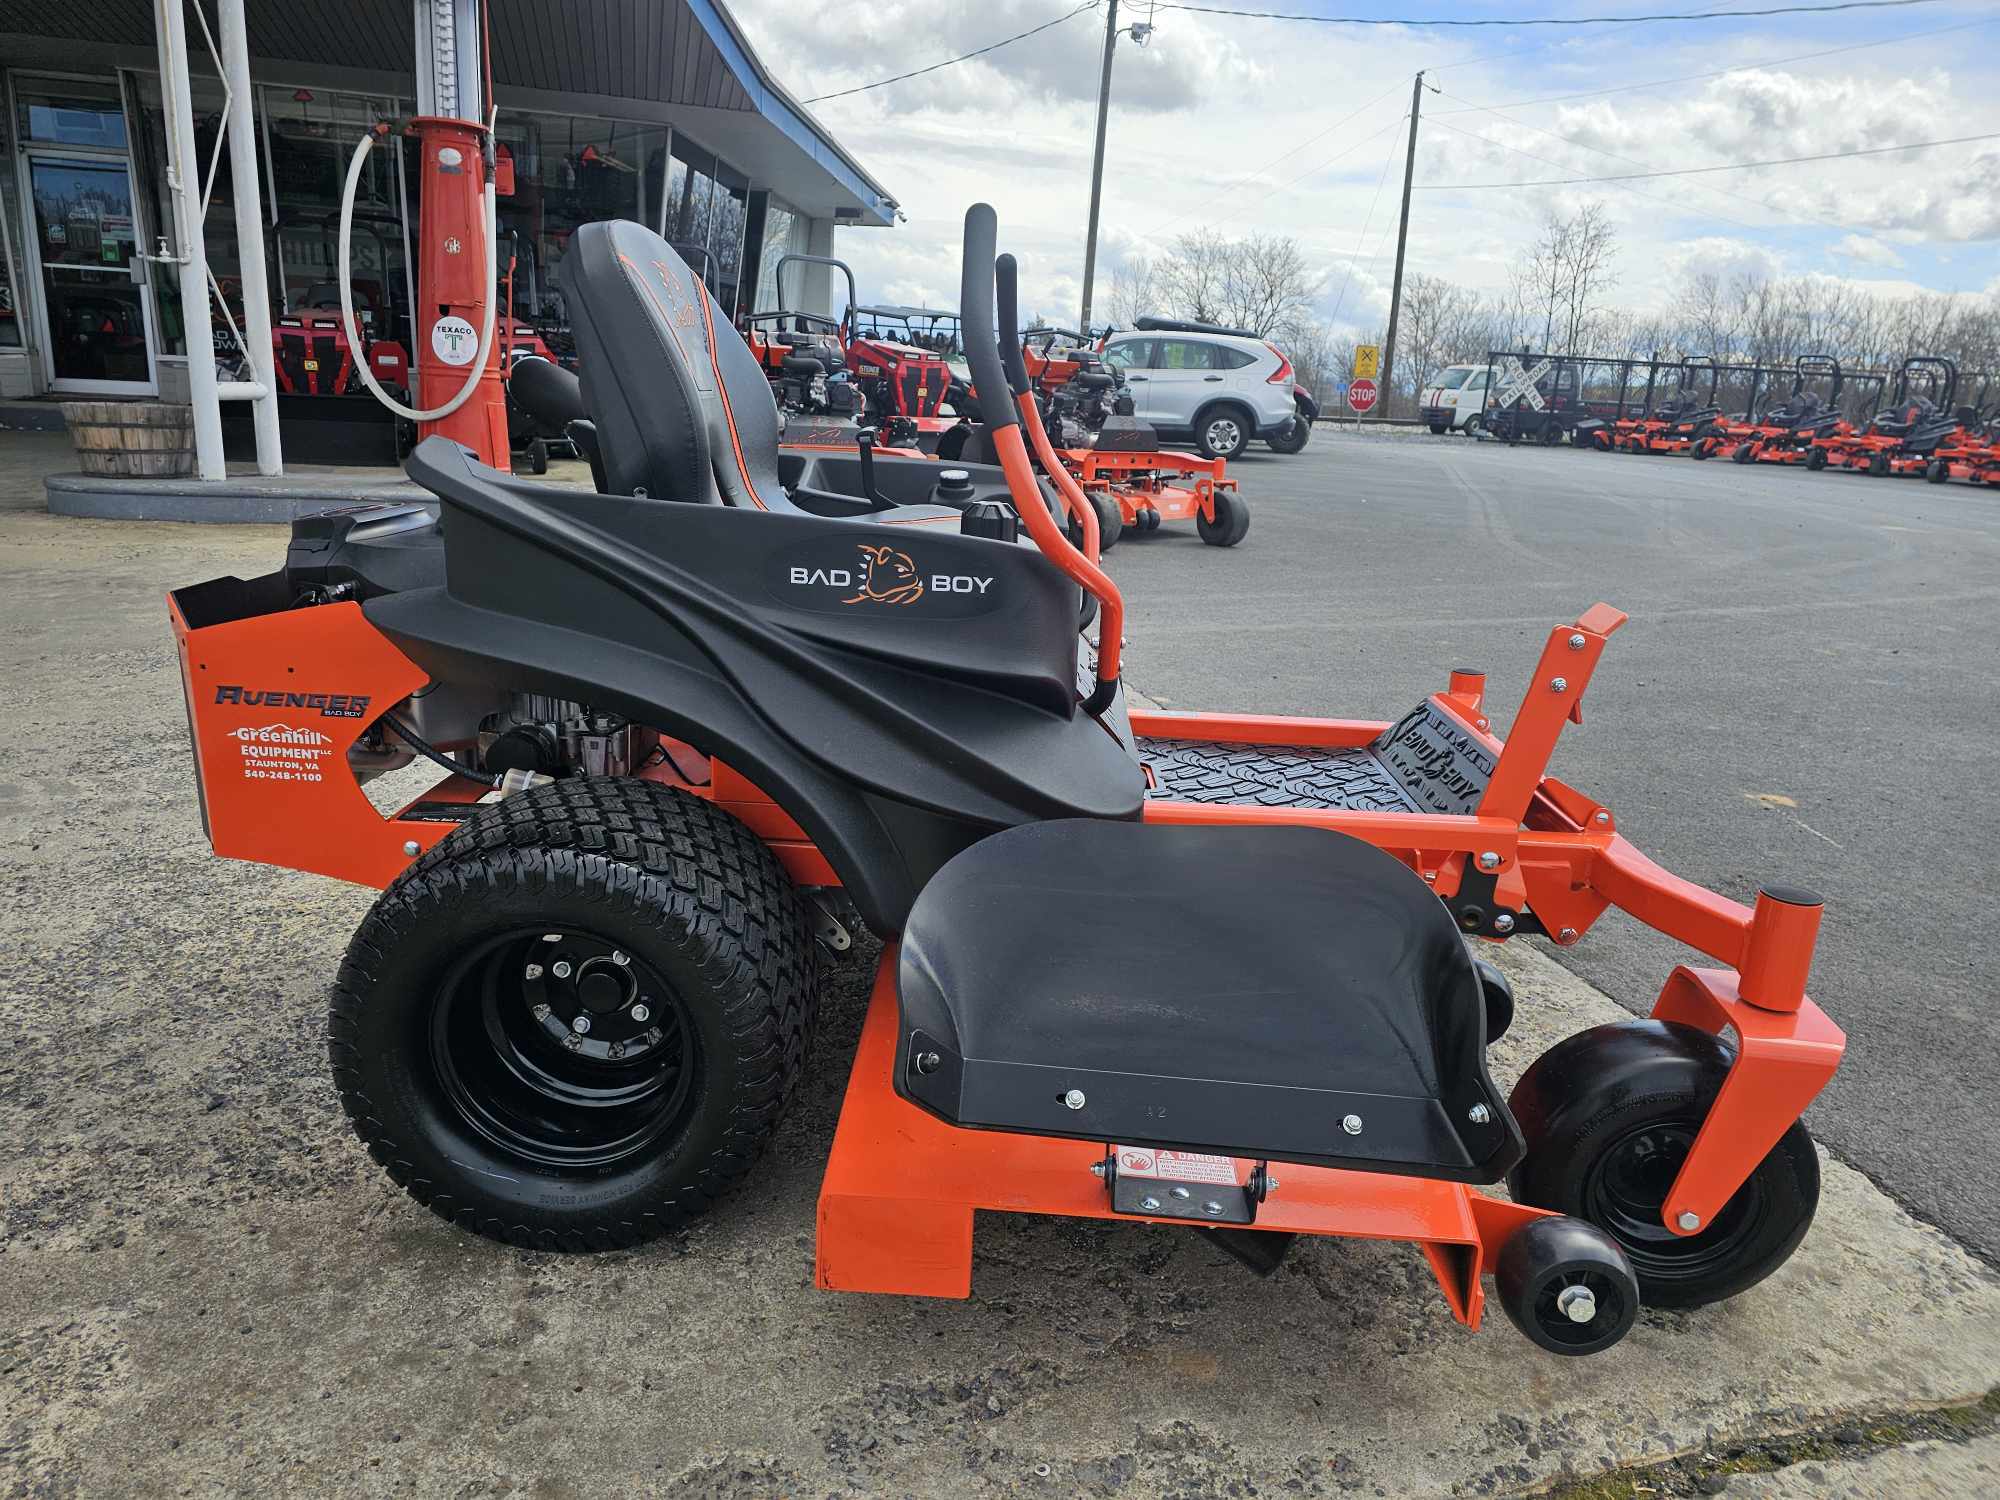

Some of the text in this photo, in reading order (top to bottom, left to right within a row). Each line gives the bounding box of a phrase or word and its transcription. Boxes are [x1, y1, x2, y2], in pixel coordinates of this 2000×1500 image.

[437, 326, 472, 335] TEXACO
[1508, 358, 1543, 408] CROSSING
[1350, 388, 1376, 401] STOP
[790, 567, 994, 594] BAD BOY
[215, 685, 371, 711] AVENGER
[237, 727, 321, 745] Greenhill
[241, 745, 320, 760] EQUIPMENT
[245, 759, 303, 771] STAUNTON,
[1402, 729, 1481, 801] BAD BOY
[244, 770, 322, 782] 540-248-1100
[1179, 1152, 1230, 1165] DANGER
